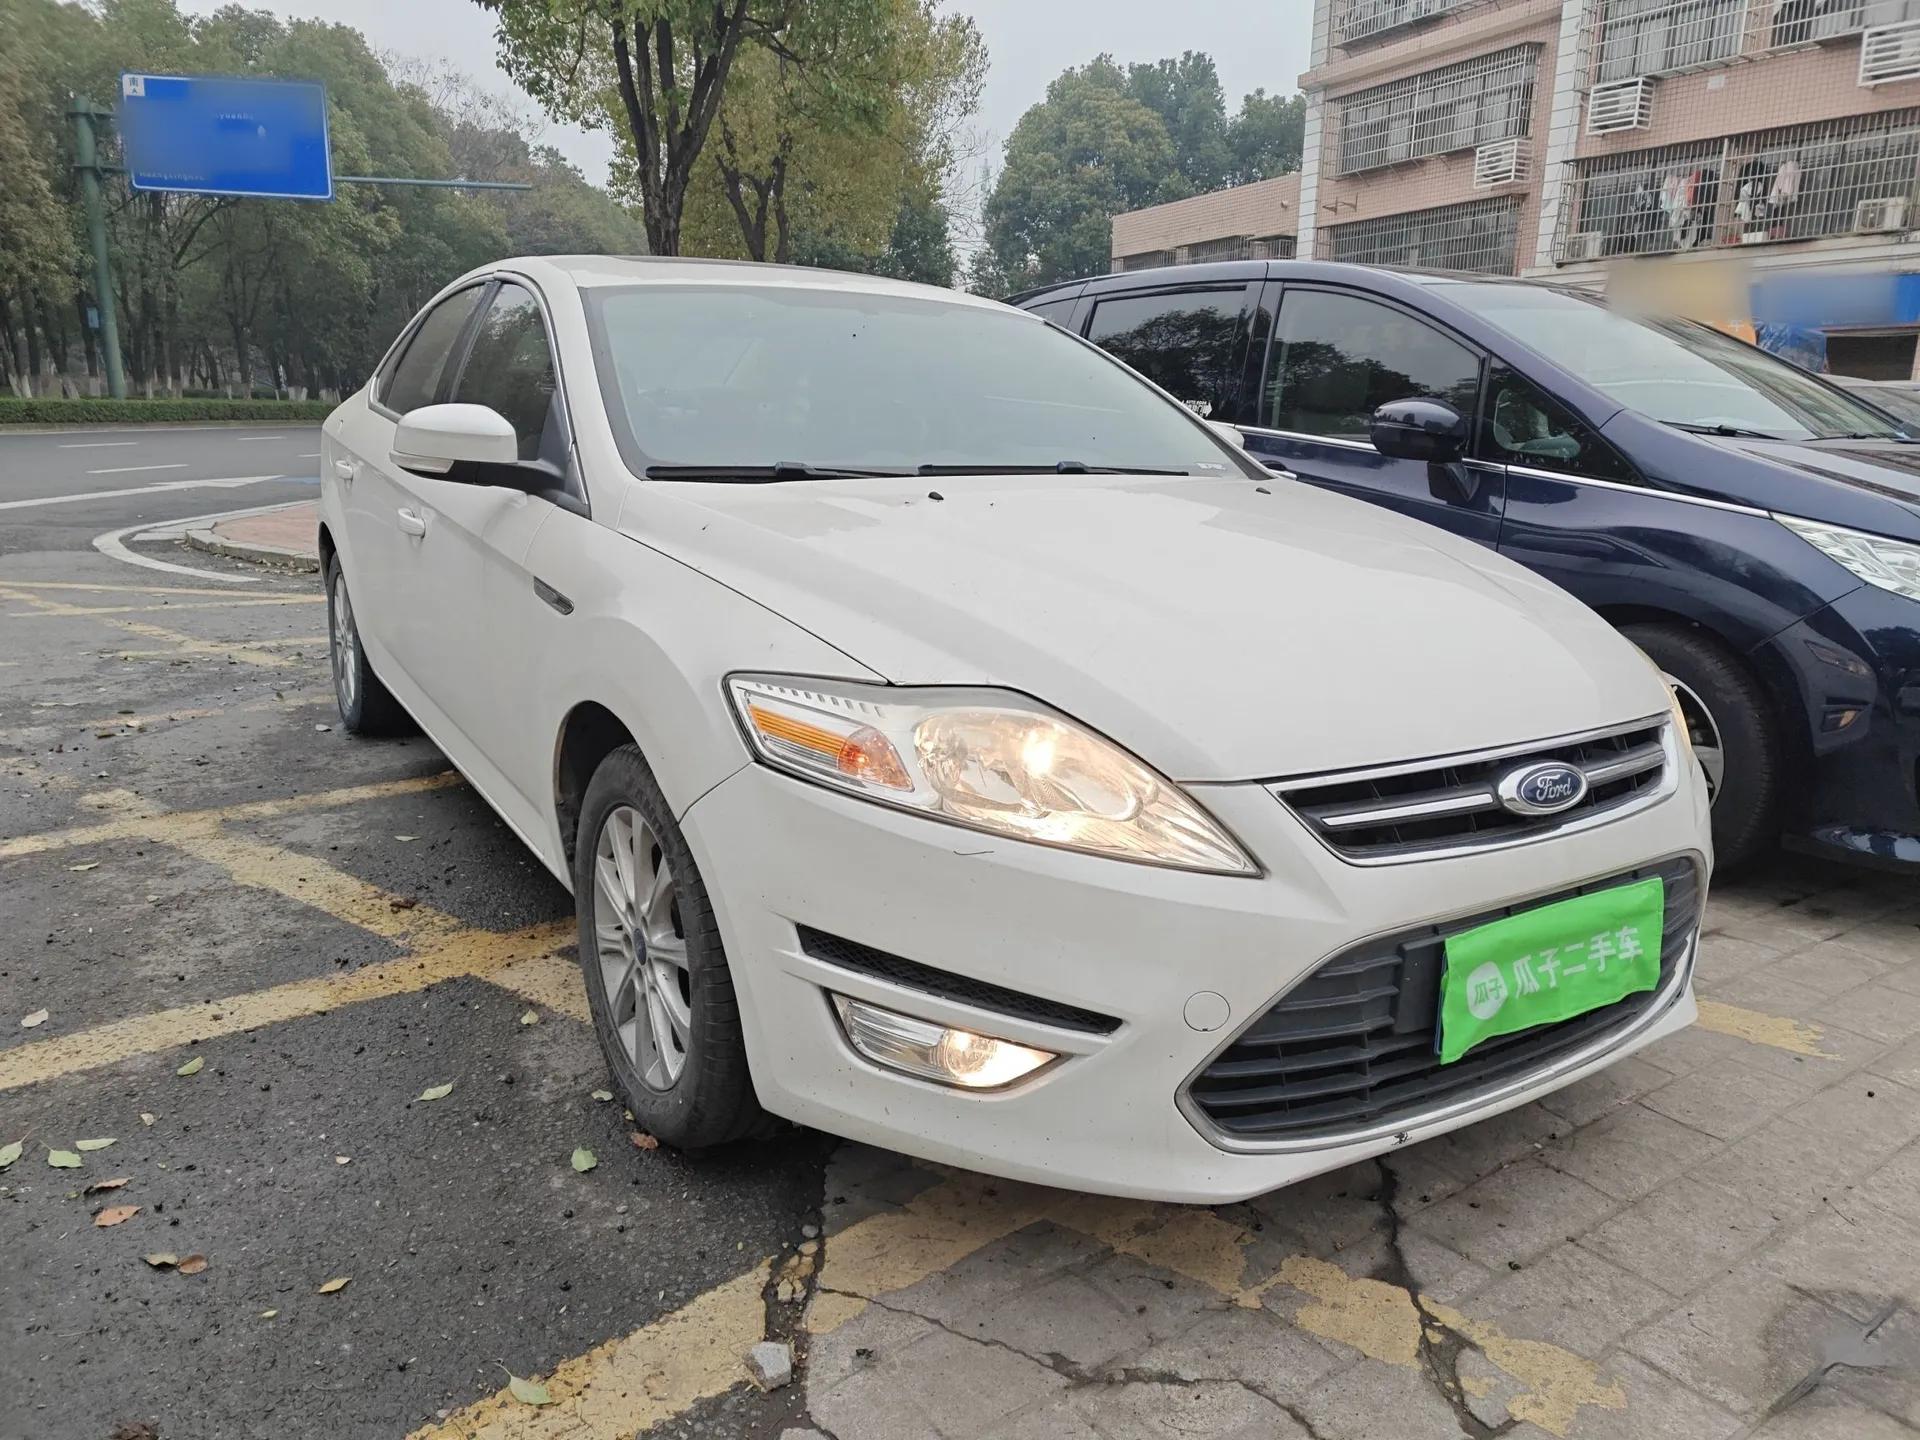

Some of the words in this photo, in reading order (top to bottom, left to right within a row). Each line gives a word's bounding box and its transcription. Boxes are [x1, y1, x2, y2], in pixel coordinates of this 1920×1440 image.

[1536, 775, 1573, 801] Ford
[1513, 926, 1643, 998] 瓜子二手车
[1474, 978, 1503, 1006] 瓜子
